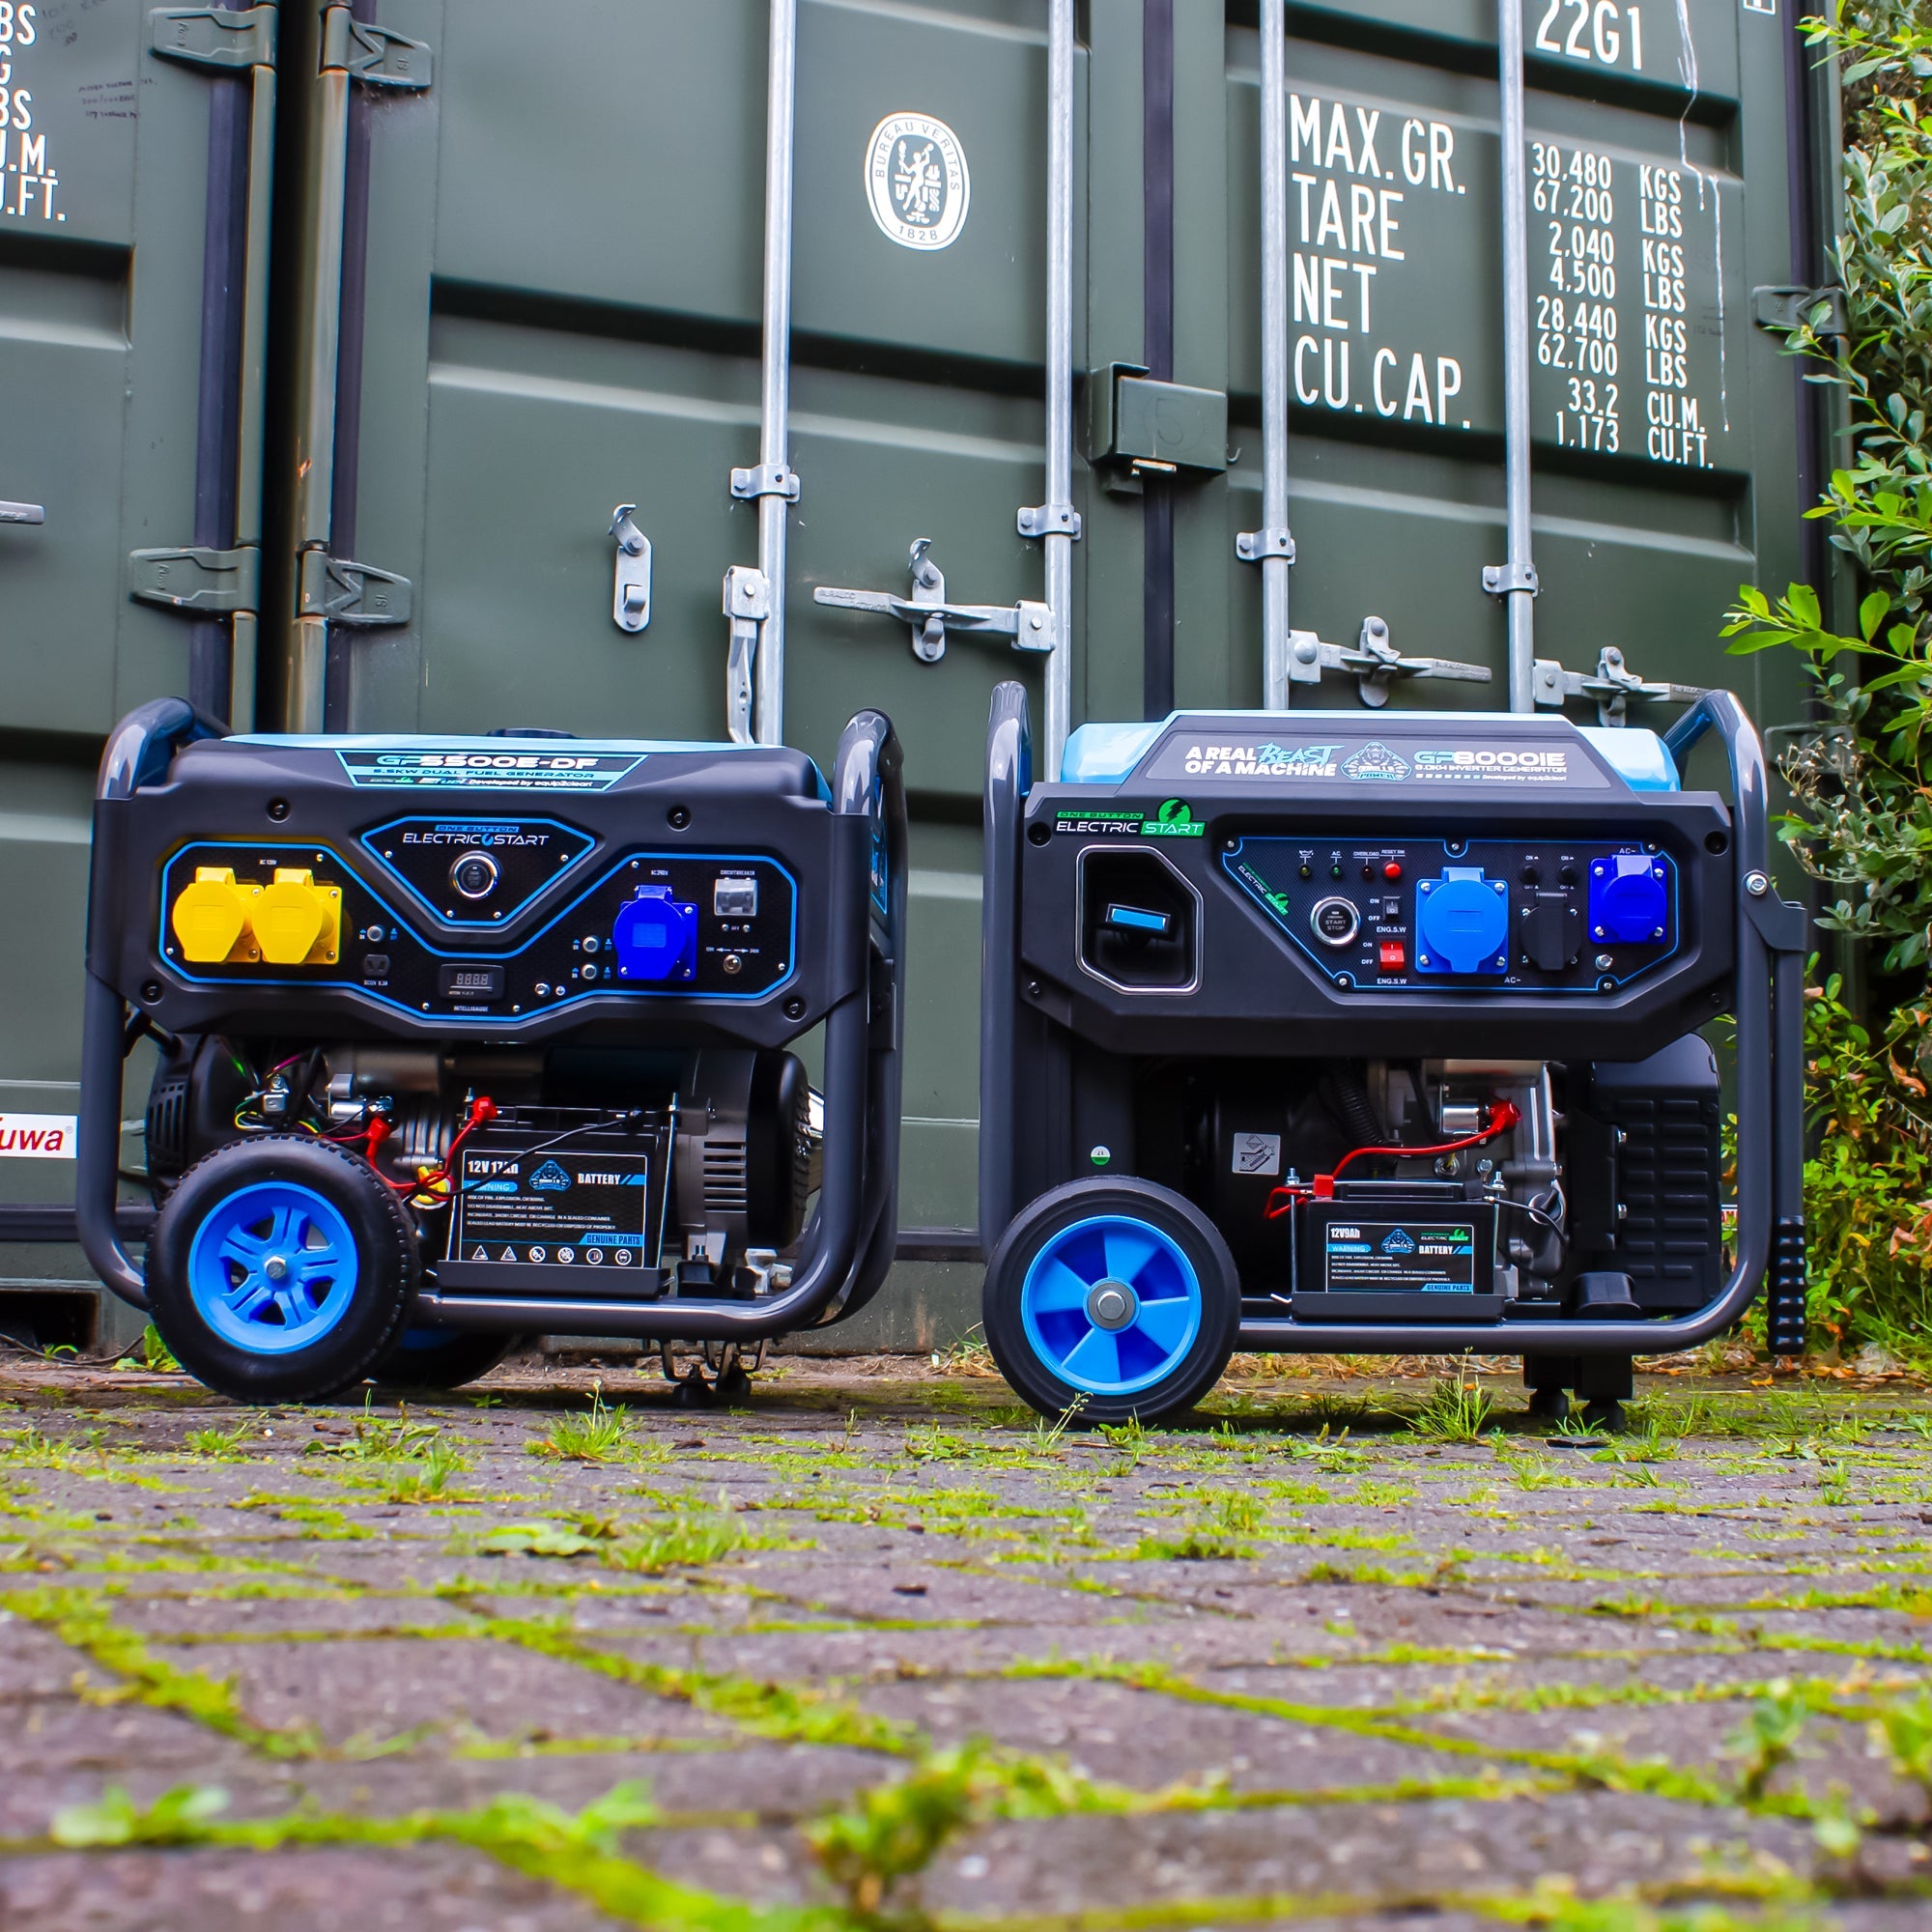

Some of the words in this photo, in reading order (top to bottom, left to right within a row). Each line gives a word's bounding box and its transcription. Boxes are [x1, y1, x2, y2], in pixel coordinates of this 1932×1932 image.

[1534, 0, 1642, 71] 22G1
[875, 122, 914, 178] BUREAU
[922, 123, 960, 190] VERITAS
[0, 172, 66, 221] .FT.
[1640, 165, 1681, 205] KGS
[899, 226, 938, 241] 1828
[1292, 172, 1406, 261] TARE
[1640, 201, 1683, 239] LBS
[1641, 238, 1685, 278] KGS
[1293, 252, 1378, 333] NET
[1643, 272, 1686, 313] LBS
[1645, 313, 1687, 354] KGS
[1646, 348, 1688, 388] LBS
[1568, 377, 1619, 418] 33.2
[1184, 760, 1214, 774] OF
[1215, 761, 1234, 775] A
[1235, 761, 1337, 777] MACHINE
[1185, 746, 1203, 760] A
[1205, 747, 1257, 761] REAL
[1257, 742, 1345, 765] BEAST
[402, 833, 481, 844] ELECTRIC
[493, 835, 550, 845] START
[1056, 821, 1139, 833] ELECTRIC
[1144, 822, 1204, 834] START
[0, 1117, 65, 1151] uwa
[468, 1160, 490, 1174] 12V
[577, 1173, 621, 1185] BATTERY
[586, 1235, 617, 1244] GENUINE
[619, 1236, 639, 1245] PARTS
[1330, 1228, 1360, 1238] 12V9Ah
[1332, 1244, 1366, 1253] WARNING
[1418, 1244, 1453, 1255] BATTERY
